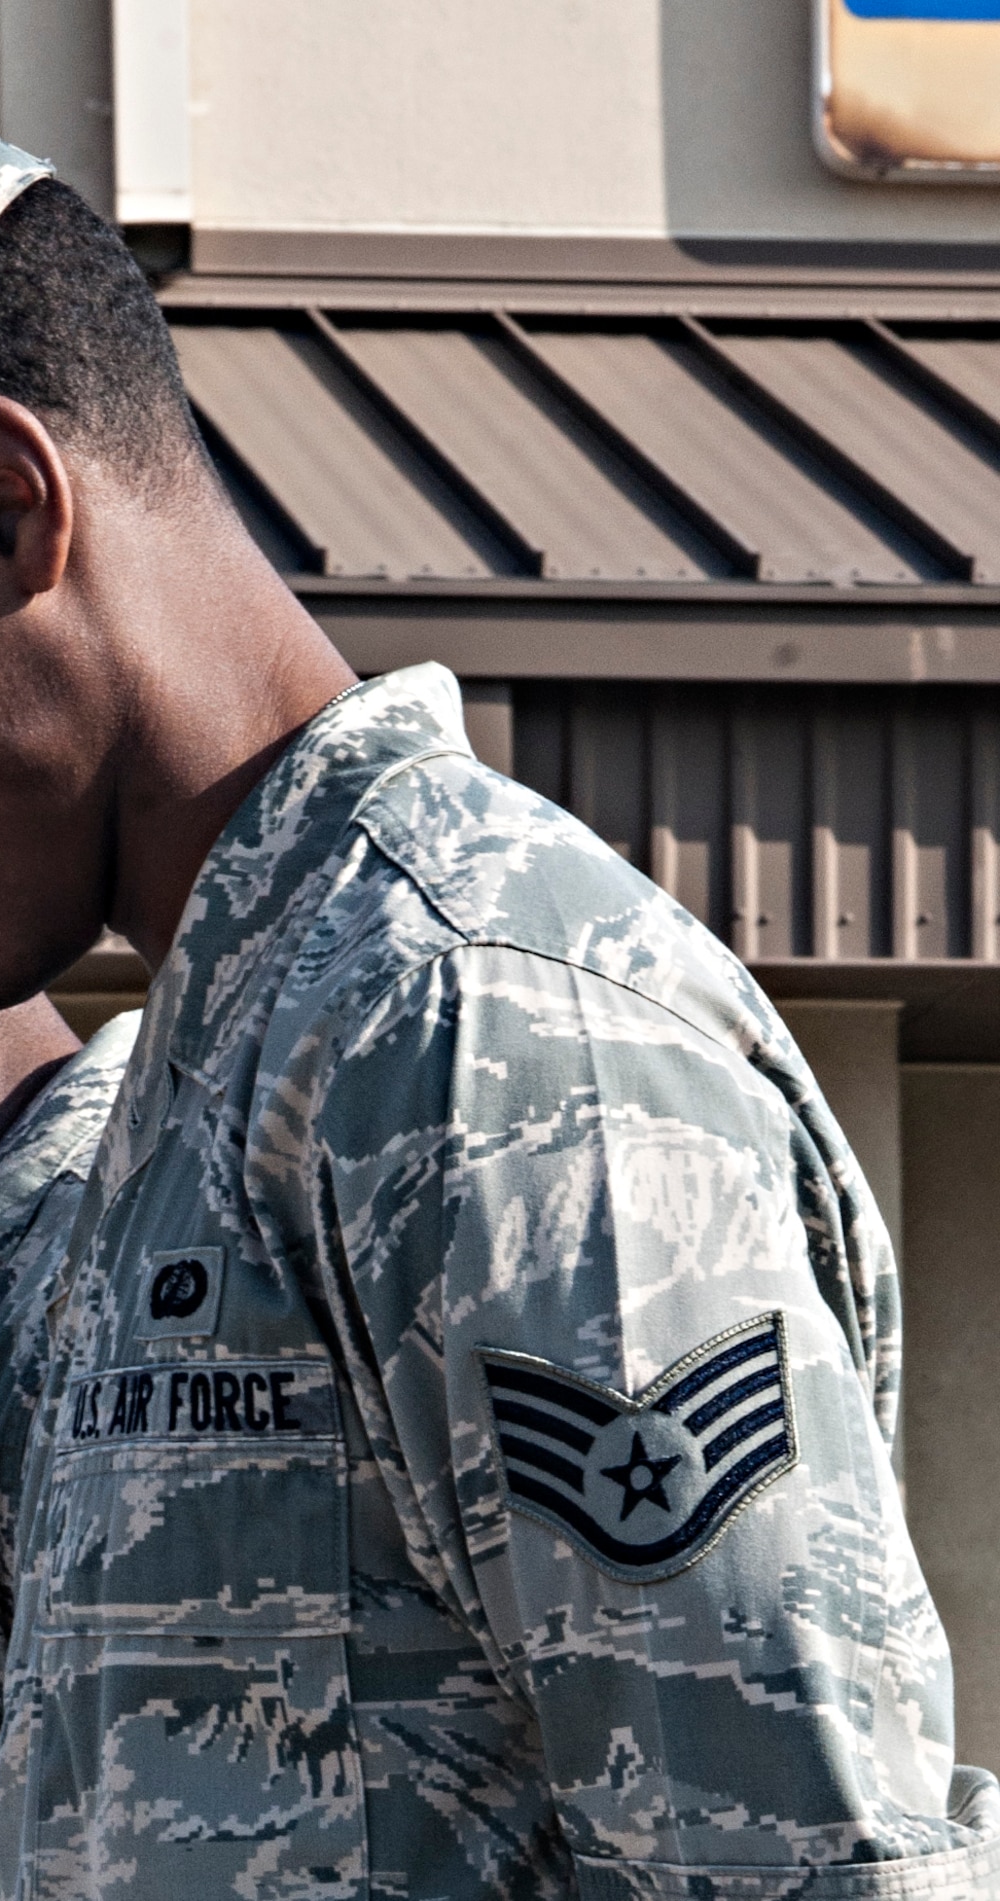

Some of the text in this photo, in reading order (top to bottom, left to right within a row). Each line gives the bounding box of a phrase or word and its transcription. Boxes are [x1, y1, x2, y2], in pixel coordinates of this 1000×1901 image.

[71, 1371, 302, 1440] U.S. AIR FORCE
